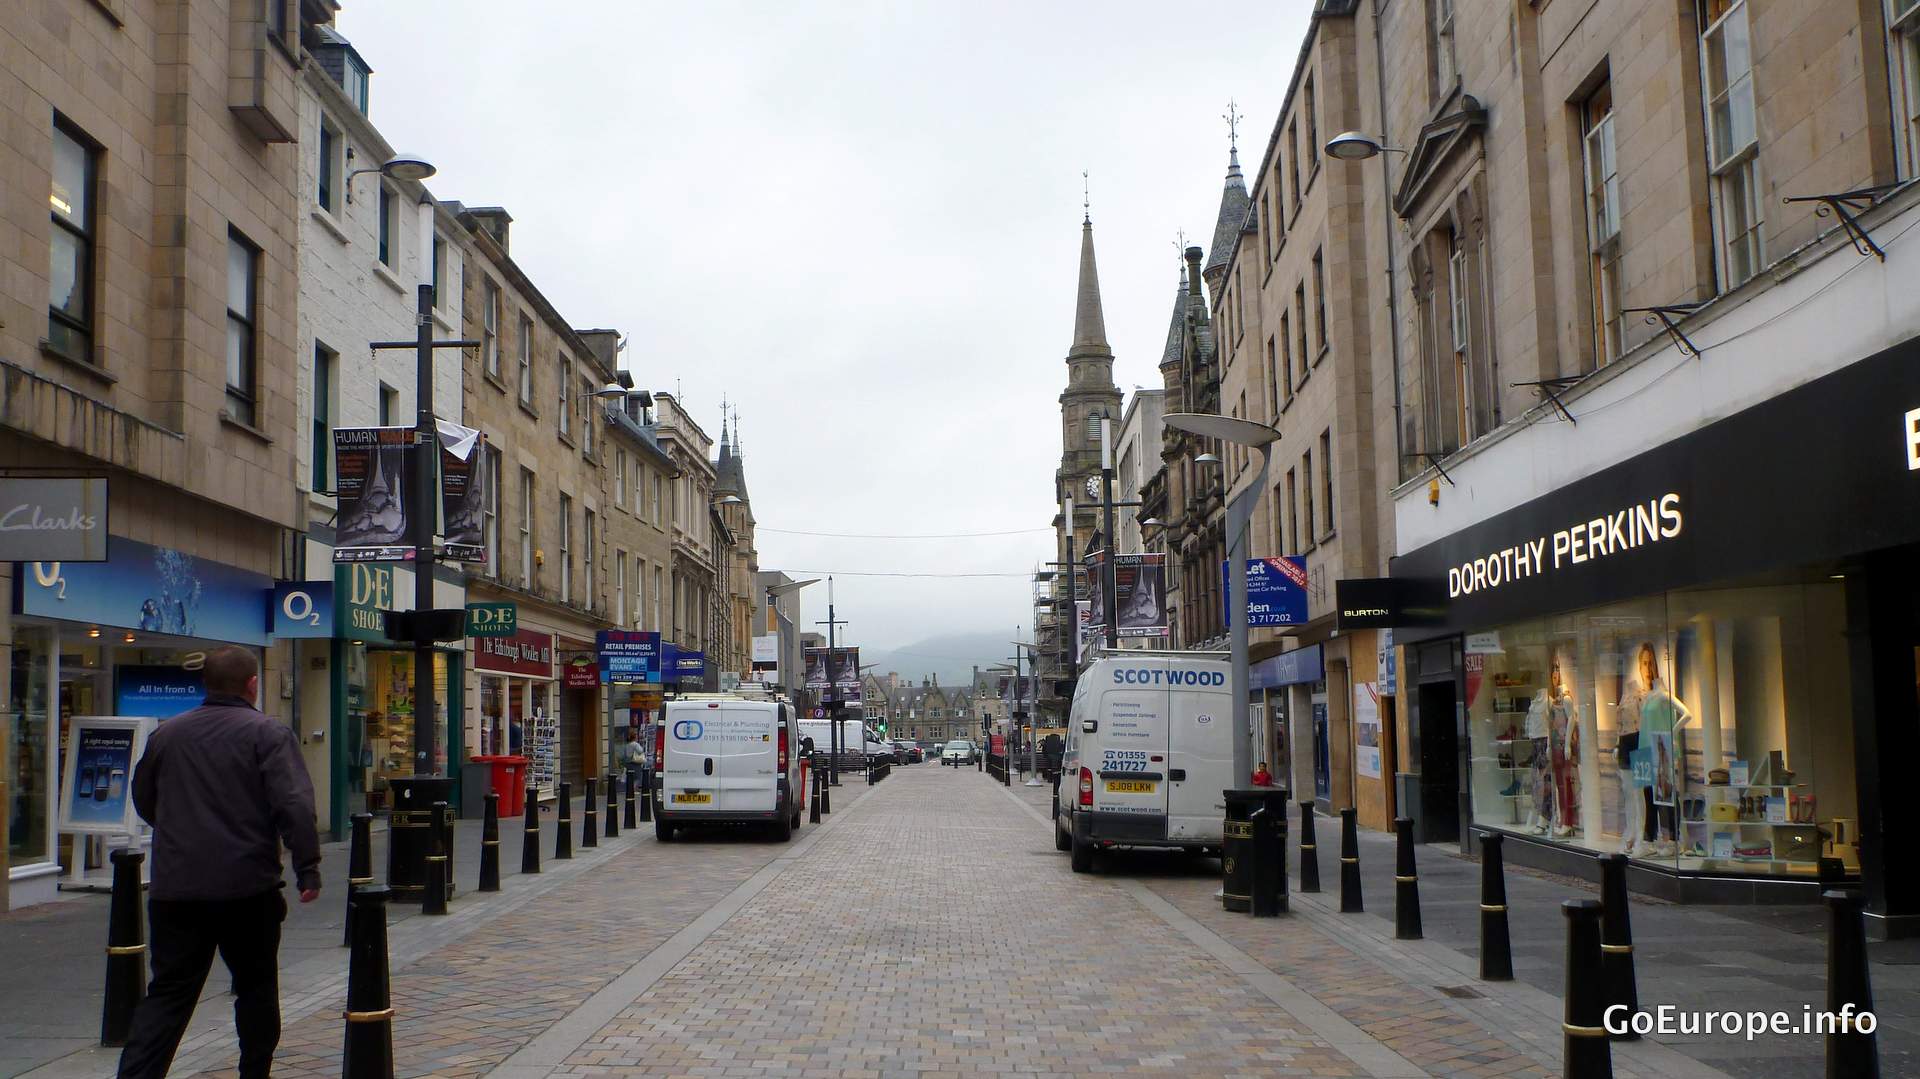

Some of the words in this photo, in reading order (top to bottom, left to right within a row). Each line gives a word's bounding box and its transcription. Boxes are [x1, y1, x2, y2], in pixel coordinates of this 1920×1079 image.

[335, 431, 377, 443] HUMAN
[1, 503, 96, 531] Clarks
[1449, 538, 1545, 599] DOROTHY
[1553, 493, 1682, 569] PERKINS
[1115, 556, 1142, 564] HUMAN
[1246, 561, 1265, 575] et
[1258, 614, 1291, 623] 717202
[1344, 609, 1389, 617] BURTON
[352, 608, 384, 632] SHOE
[483, 637, 493, 653] The
[624, 643, 652, 651] PREMISES
[1465, 654, 1483, 673] SALE
[139, 684, 152, 694] All
[164, 684, 186, 694] from
[1117, 751, 1146, 760] 01355
[1102, 761, 1147, 772] 241727
[1109, 781, 1133, 791] SJ08
